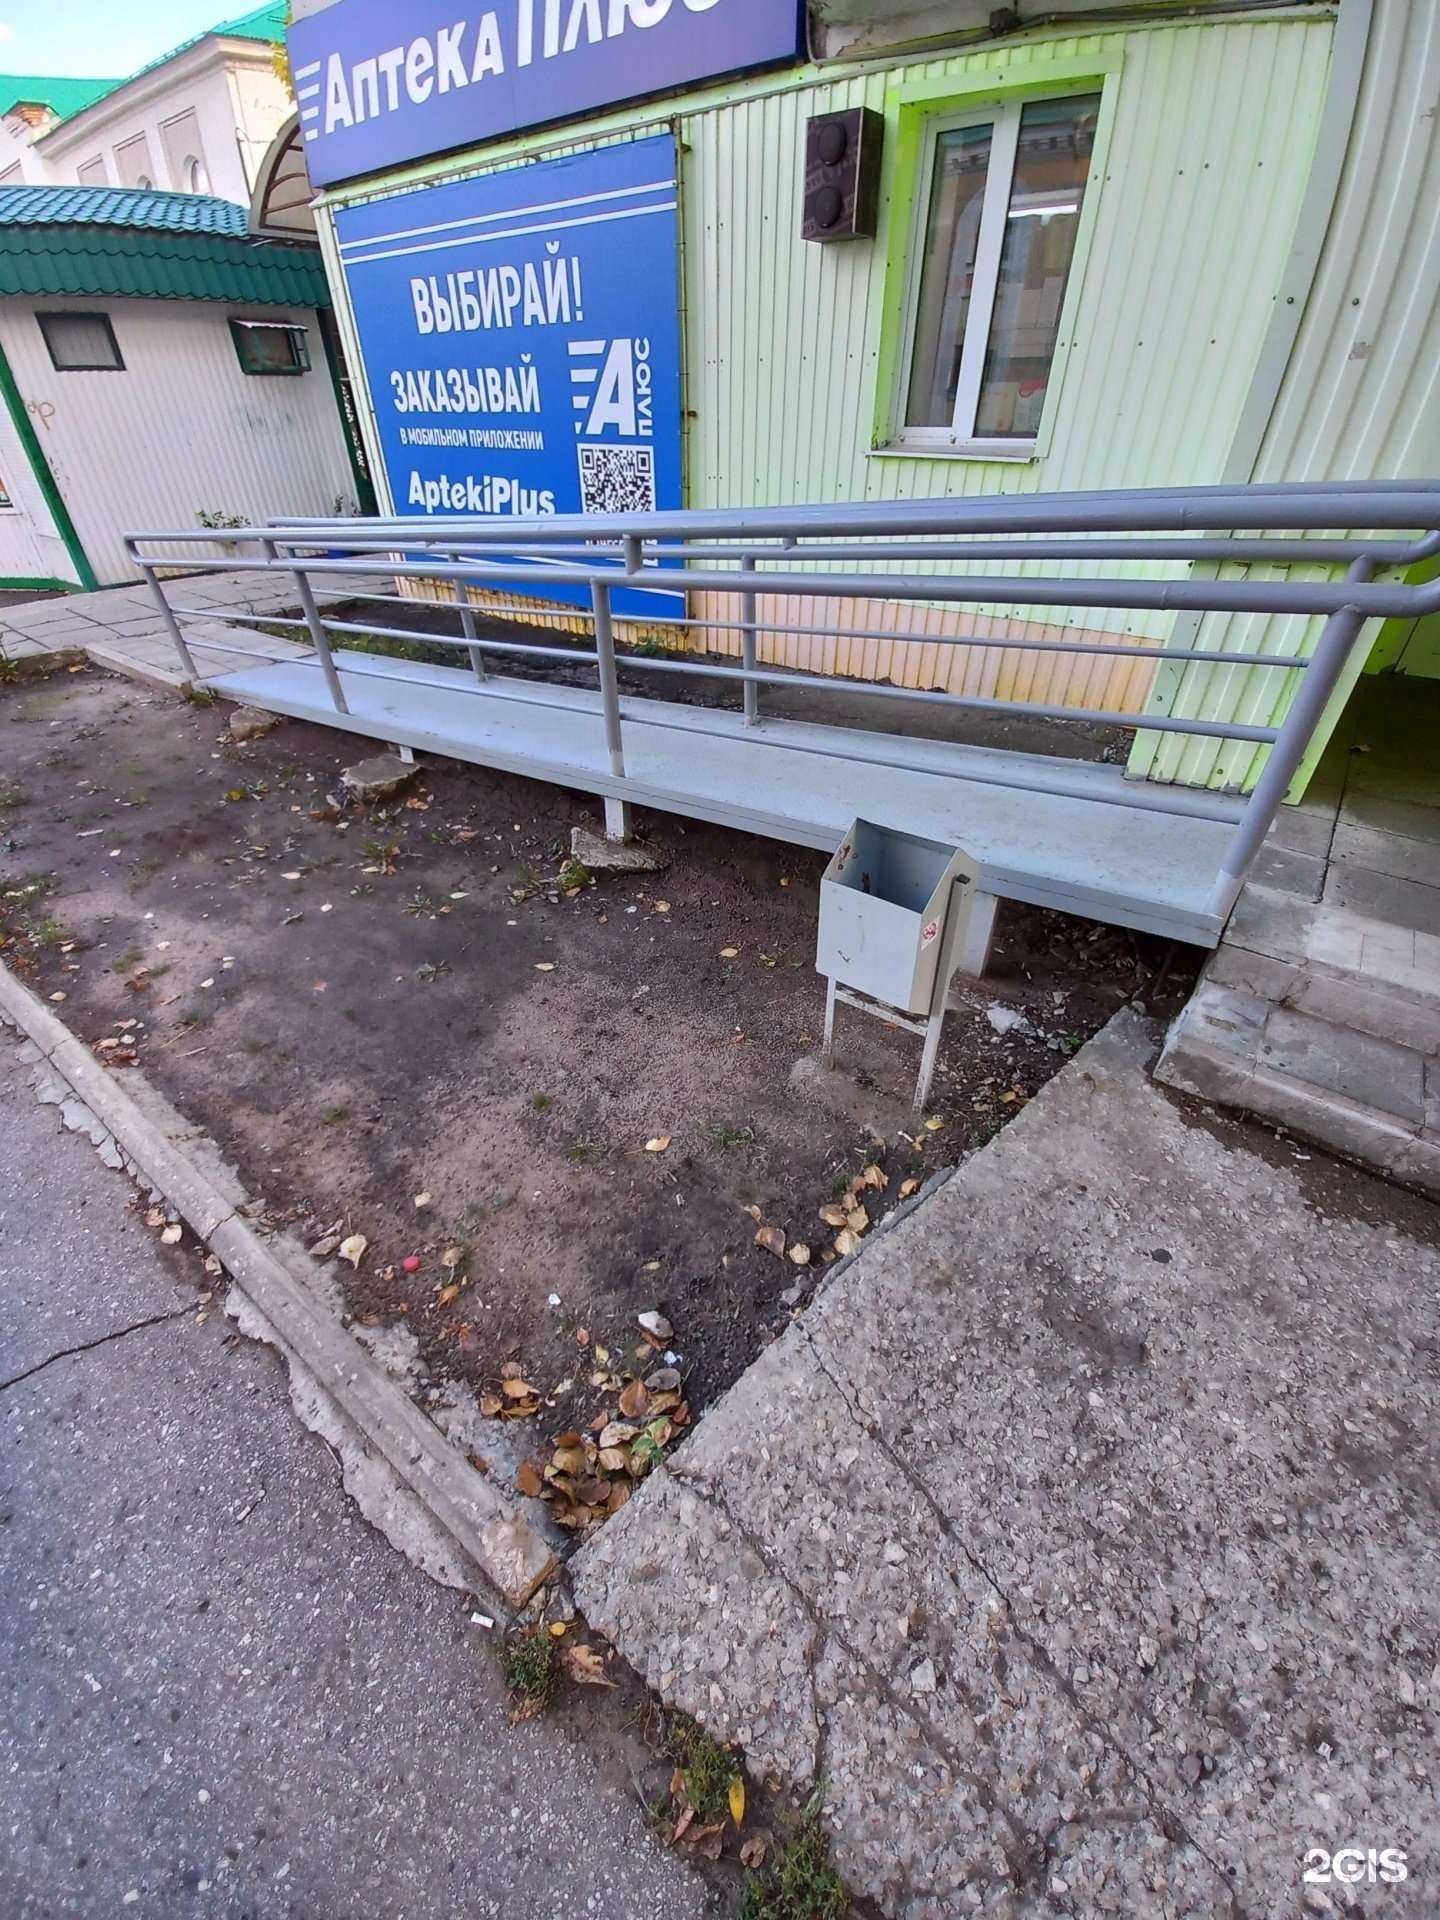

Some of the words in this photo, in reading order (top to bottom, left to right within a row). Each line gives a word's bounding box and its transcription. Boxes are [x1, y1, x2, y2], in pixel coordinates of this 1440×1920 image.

[410, 240, 584, 334] ВЫБИРАЙ!
[390, 353, 542, 414] ЗАКАЗЫВАЙ
[635, 337, 653, 436] ПЛЮС
[400, 427, 408, 445] В
[407, 428, 468, 447] МОБИЛЬНОМ
[468, 429, 544, 450] ПРИЛОЖЕНИИ
[408, 470, 556, 515] AptekiPlus
